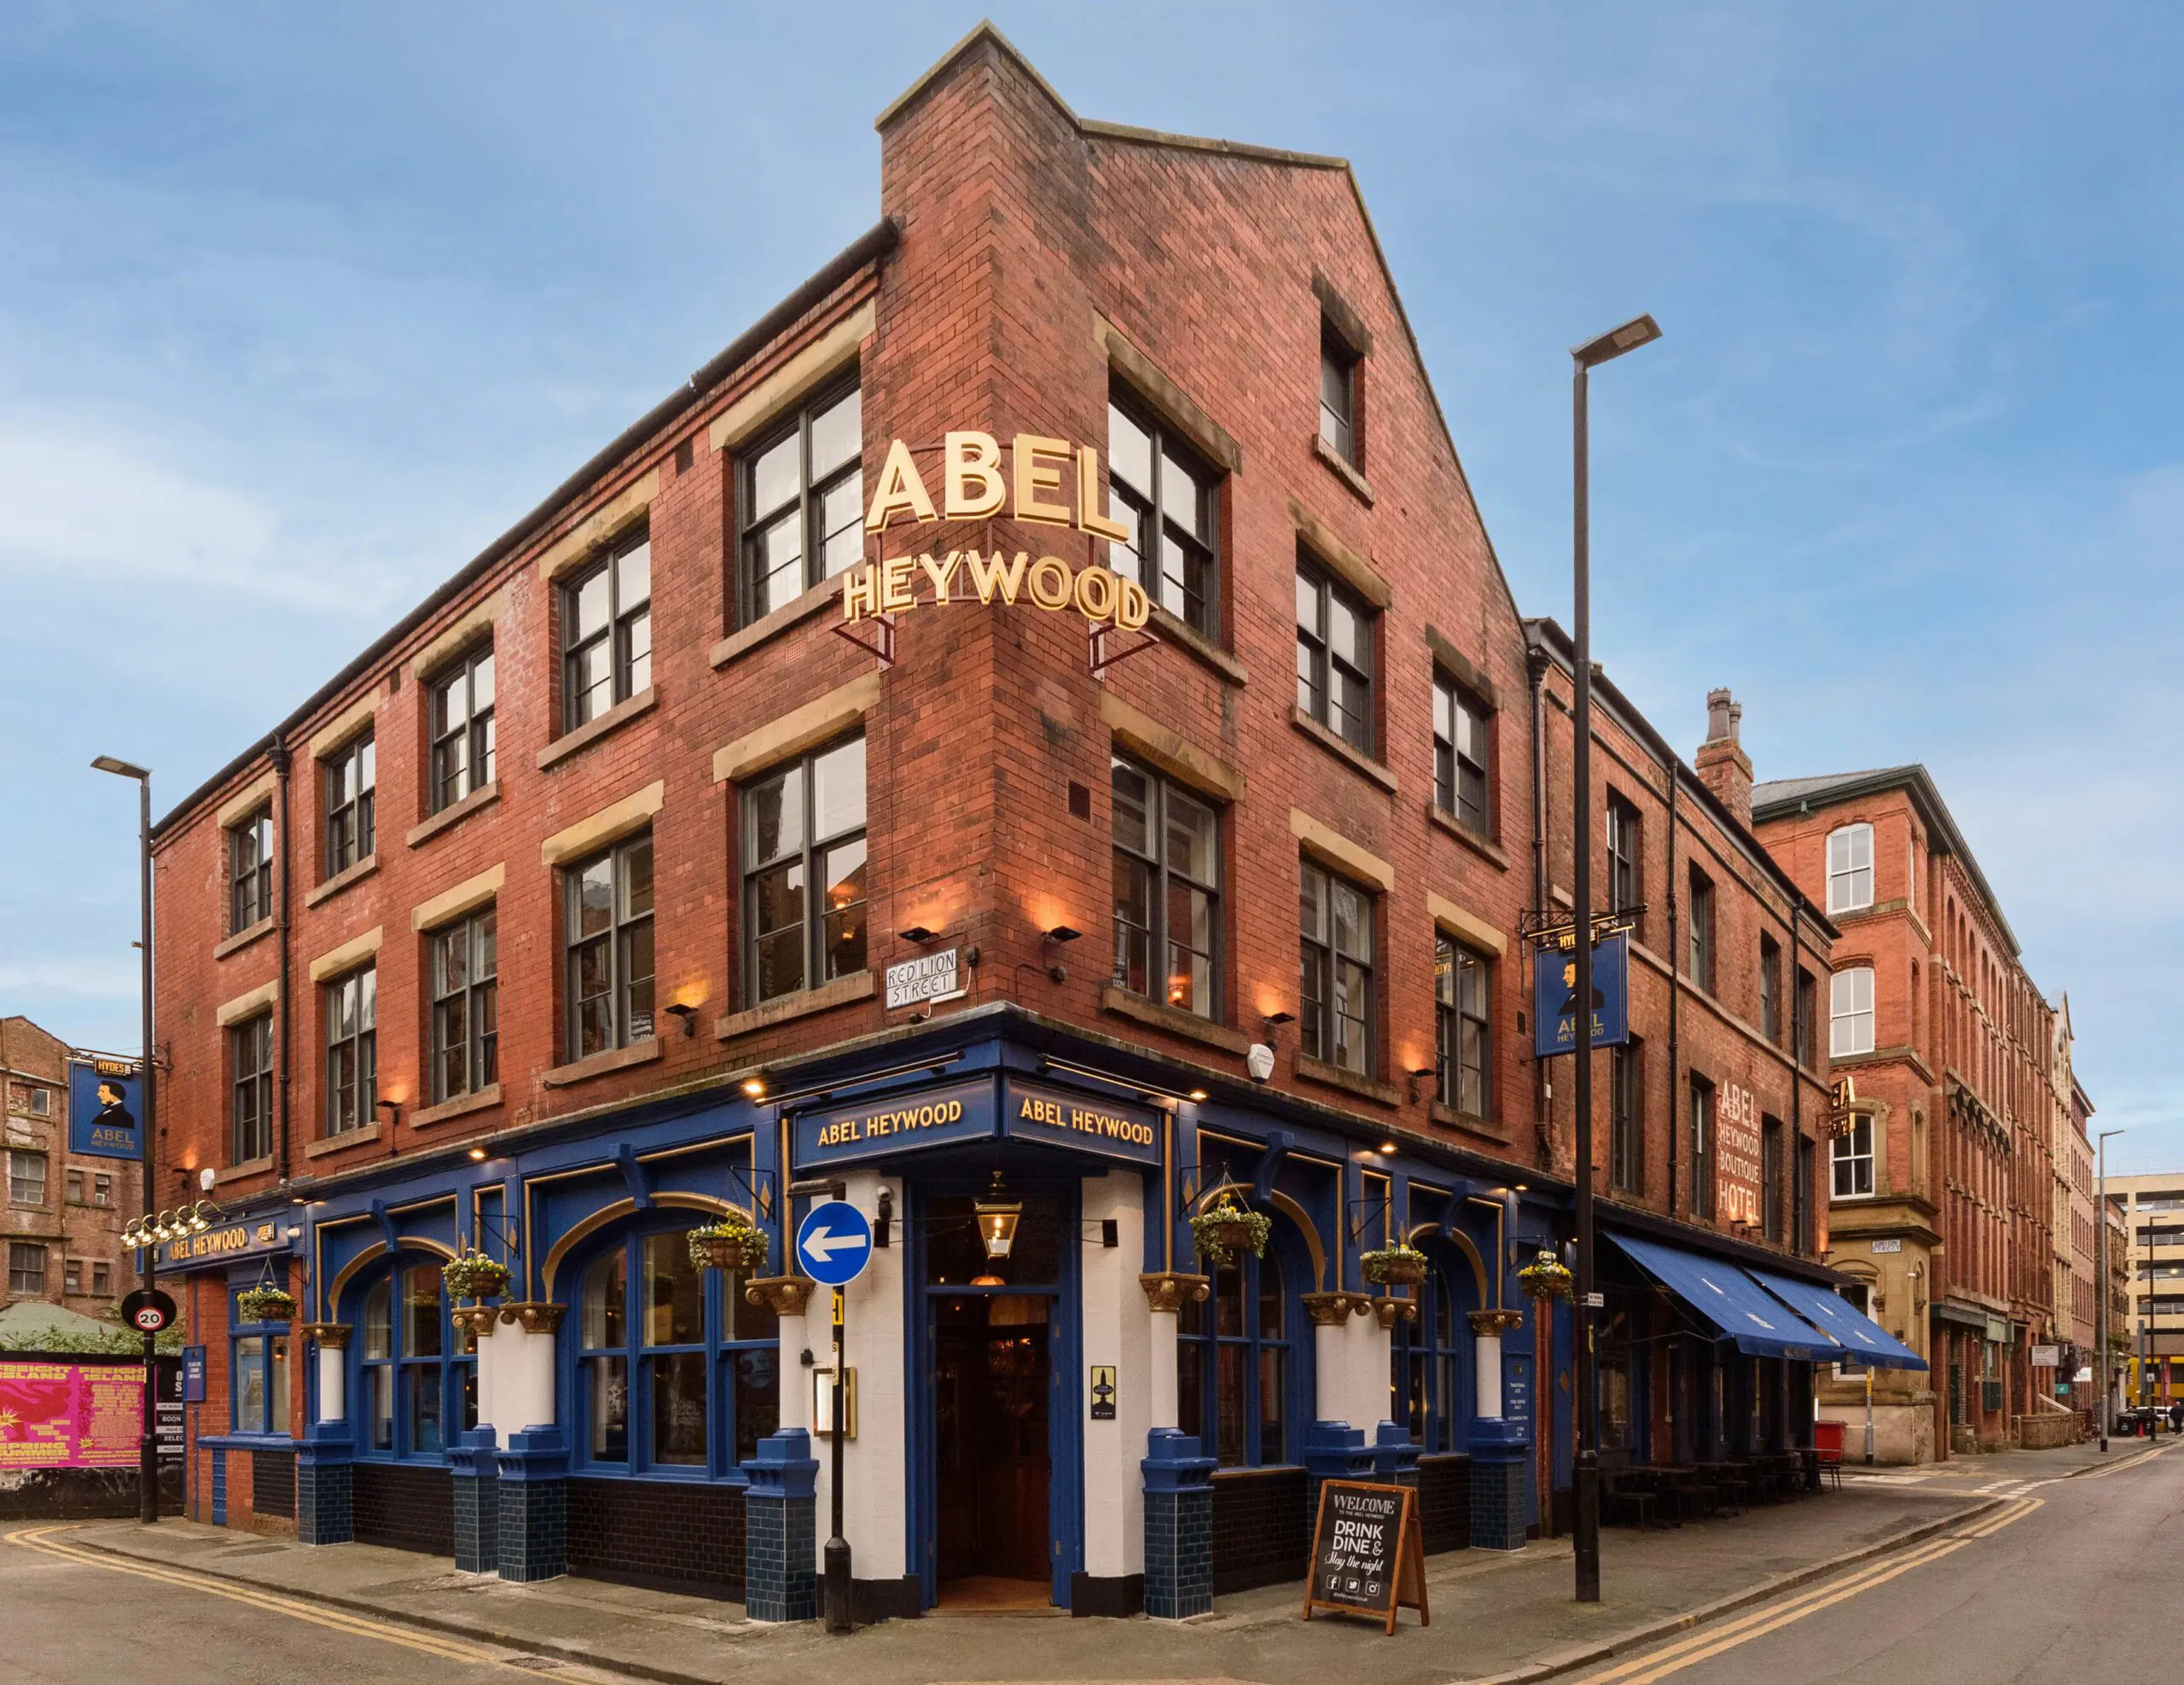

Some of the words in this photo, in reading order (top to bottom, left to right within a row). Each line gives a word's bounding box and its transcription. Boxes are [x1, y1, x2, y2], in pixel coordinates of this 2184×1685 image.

[865, 431, 1129, 545] ABEL
[843, 550, 1150, 631] HEYWOOD
[888, 965, 915, 986] RED
[921, 953, 954, 977] LION
[894, 973, 949, 1002] STREET
[1557, 1027, 1604, 1043] HEYOD
[1558, 1013, 1604, 1034] AL
[98, 1060, 125, 1073] HYDES
[1720, 1079, 1758, 1131] ABEL
[92, 1128, 134, 1144] ABEL
[818, 1121, 861, 1147] ABEL
[866, 1101, 961, 1137] HEYWOOD
[1020, 1097, 1066, 1127] ABEL
[1072, 1108, 1153, 1145] HEYWOOD
[1719, 1124, 1759, 1157] HEYWOOD
[1719, 1151, 1759, 1184] BOUTIQUE
[1718, 1178, 1759, 1223] HOTEL
[168, 1240, 190, 1261] ABEL
[193, 1227, 247, 1256] HEYWOOD
[140, 1314, 160, 1323] 20
[1333, 1495, 1395, 1514] WELCOME
[1333, 1536, 1370, 1554] DINE
[1372, 1541, 1383, 1555] &
[1334, 1520, 1384, 1540] DRINK
[1324, 1551, 1345, 1571] Stay
[1346, 1554, 1360, 1569] the
[1361, 1558, 1385, 1576] night
